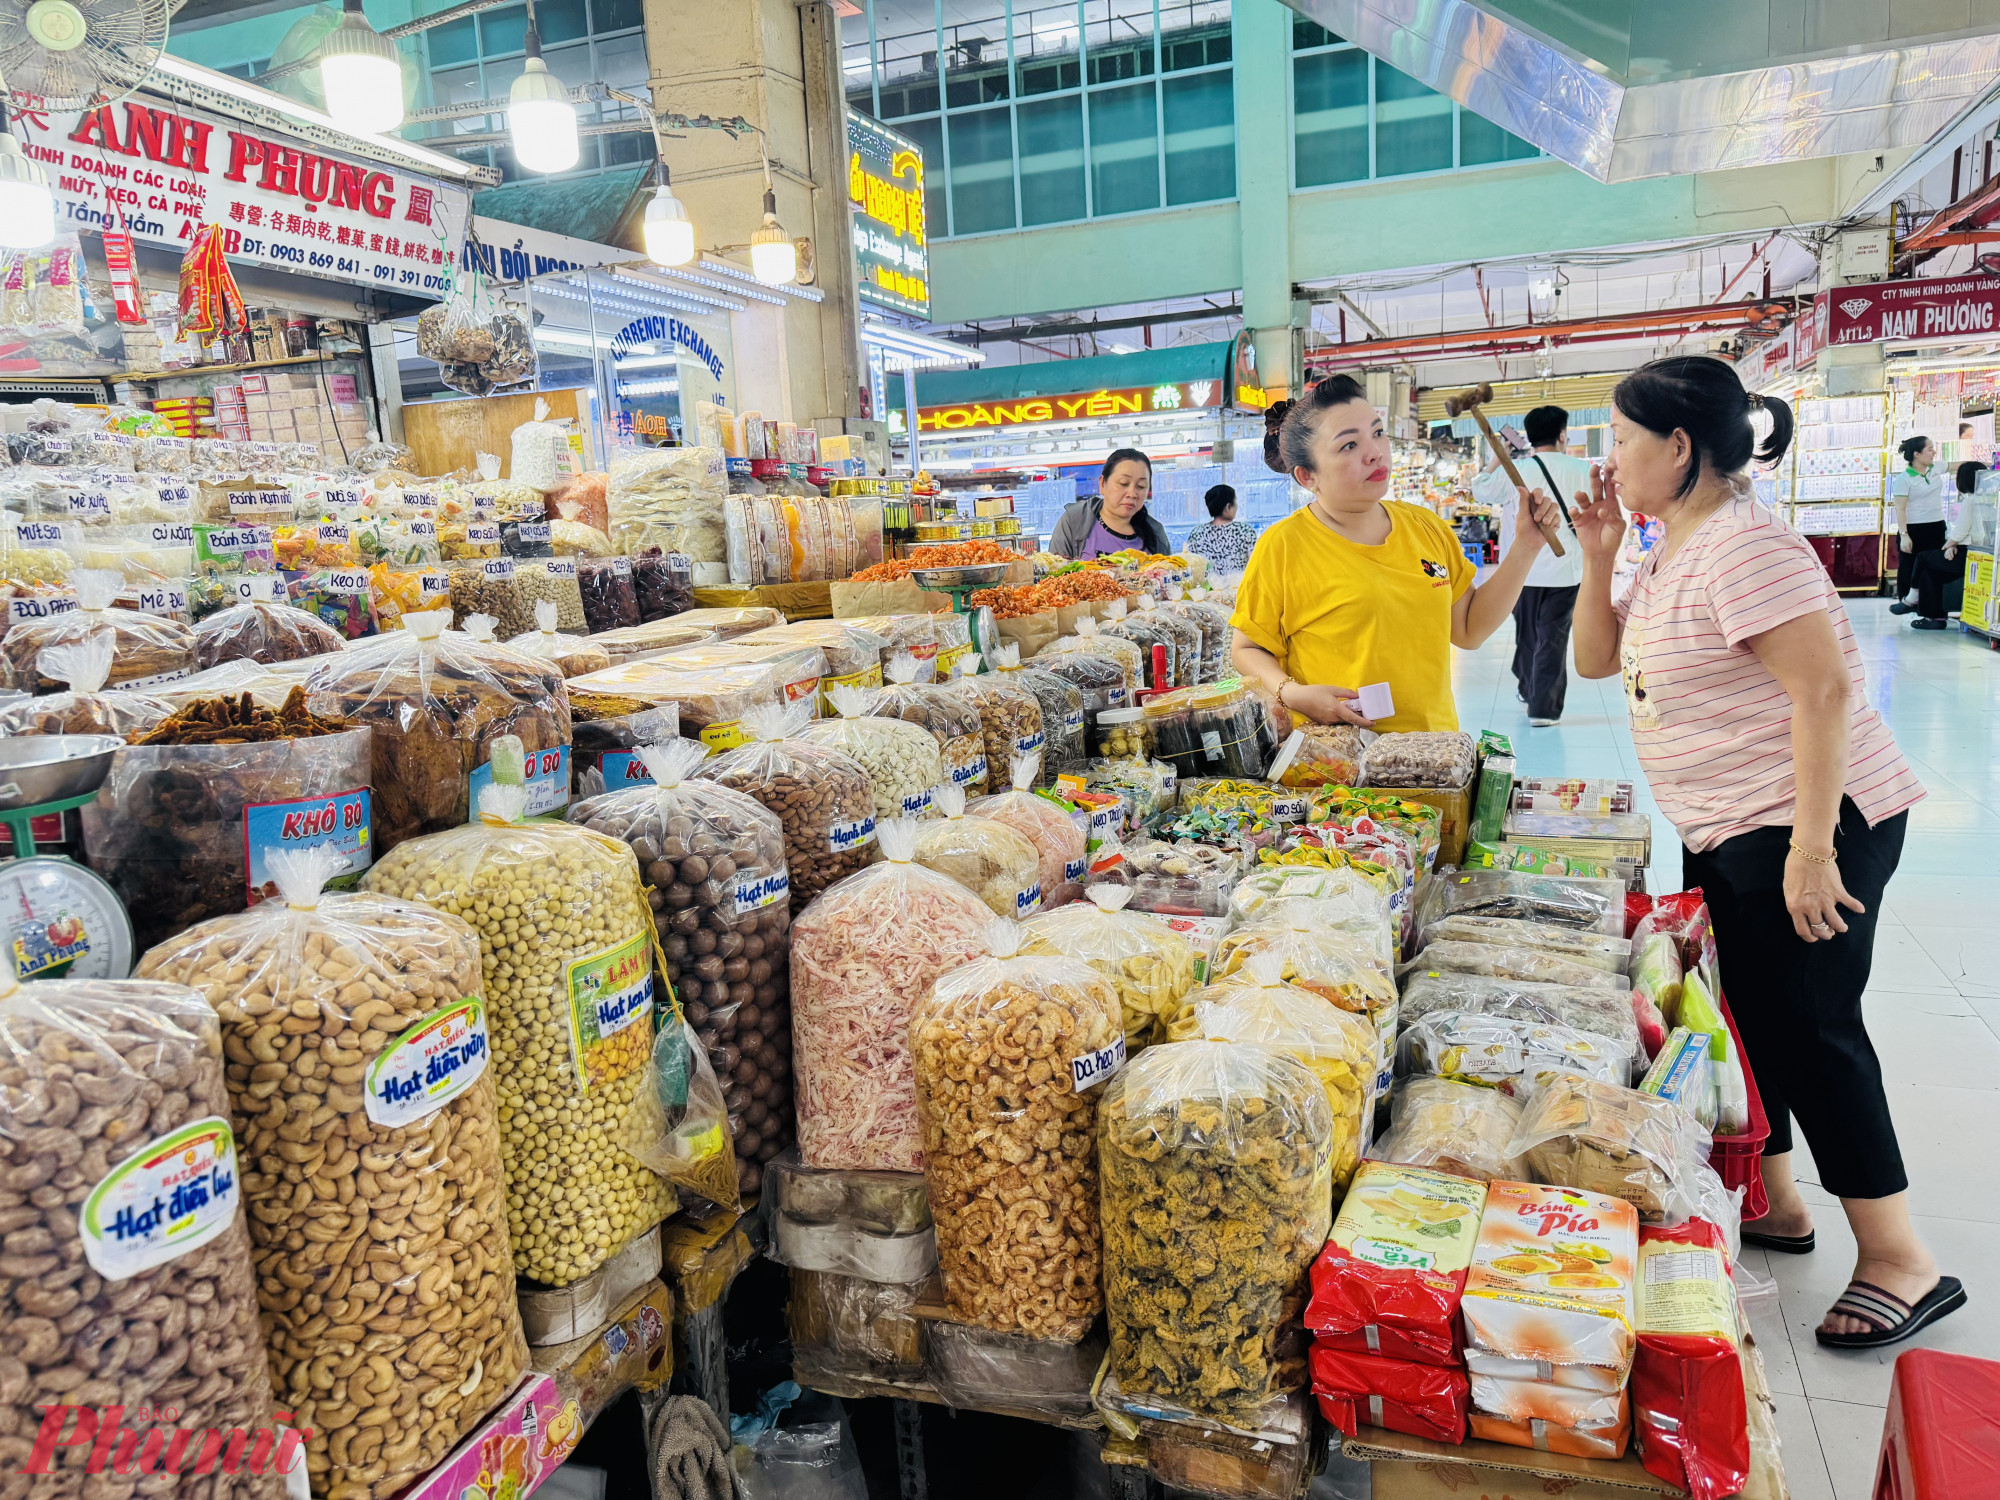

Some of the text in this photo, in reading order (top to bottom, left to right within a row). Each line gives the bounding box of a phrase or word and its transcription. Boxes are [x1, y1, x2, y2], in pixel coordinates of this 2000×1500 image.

[21, 142, 64, 166] KINH
[71, 154, 127, 181] DOANH
[133, 168, 164, 189] CÁC
[68, 95, 396, 220] ANH PHỤNG
[58, 175, 99, 200] MỨT,
[148, 194, 169, 212] CÀ
[66, 202, 164, 236] Tầng Hầm
[243, 238, 266, 258] ĐT:
[270, 243, 304, 263] 0903
[308, 252, 334, 268] 869
[337, 258, 360, 274] 841
[373, 265, 396, 281] 091
[399, 270, 420, 286] 391
[1882, 290, 1897, 300] CTY
[1899, 287, 1921, 298] TNHH
[1923, 284, 1942, 296] KINH
[1945, 281, 1974, 294] DOANH
[1881, 299, 1993, 338] NAM PHƯƠNG
[610, 316, 725, 382] CURRENCY EXCHANGE
[917, 403, 1052, 432] HOÀNG
[1057, 390, 1142, 418] YẾN
[229, 492, 257, 505] Bánh
[210, 531, 239, 547] Bánh
[542, 746, 560, 776] BÒ
[282, 795, 362, 841] KHÔ BÒ
[902, 796, 922, 812] Hạt
[830, 823, 860, 846] Hạnh
[735, 882, 763, 904] Hạt
[607, 956, 639, 985] LÂM
[597, 997, 626, 1025] Hạt
[627, 990, 645, 1013] sen
[378, 1071, 422, 1104] Hạt
[426, 1046, 462, 1085] điều
[1095, 1049, 1113, 1071] heo
[104, 1196, 166, 1240] Hạt
[169, 1175, 210, 1220] điều
[1517, 1200, 1574, 1216] Bánh
[1537, 1213, 1600, 1237] Pía
